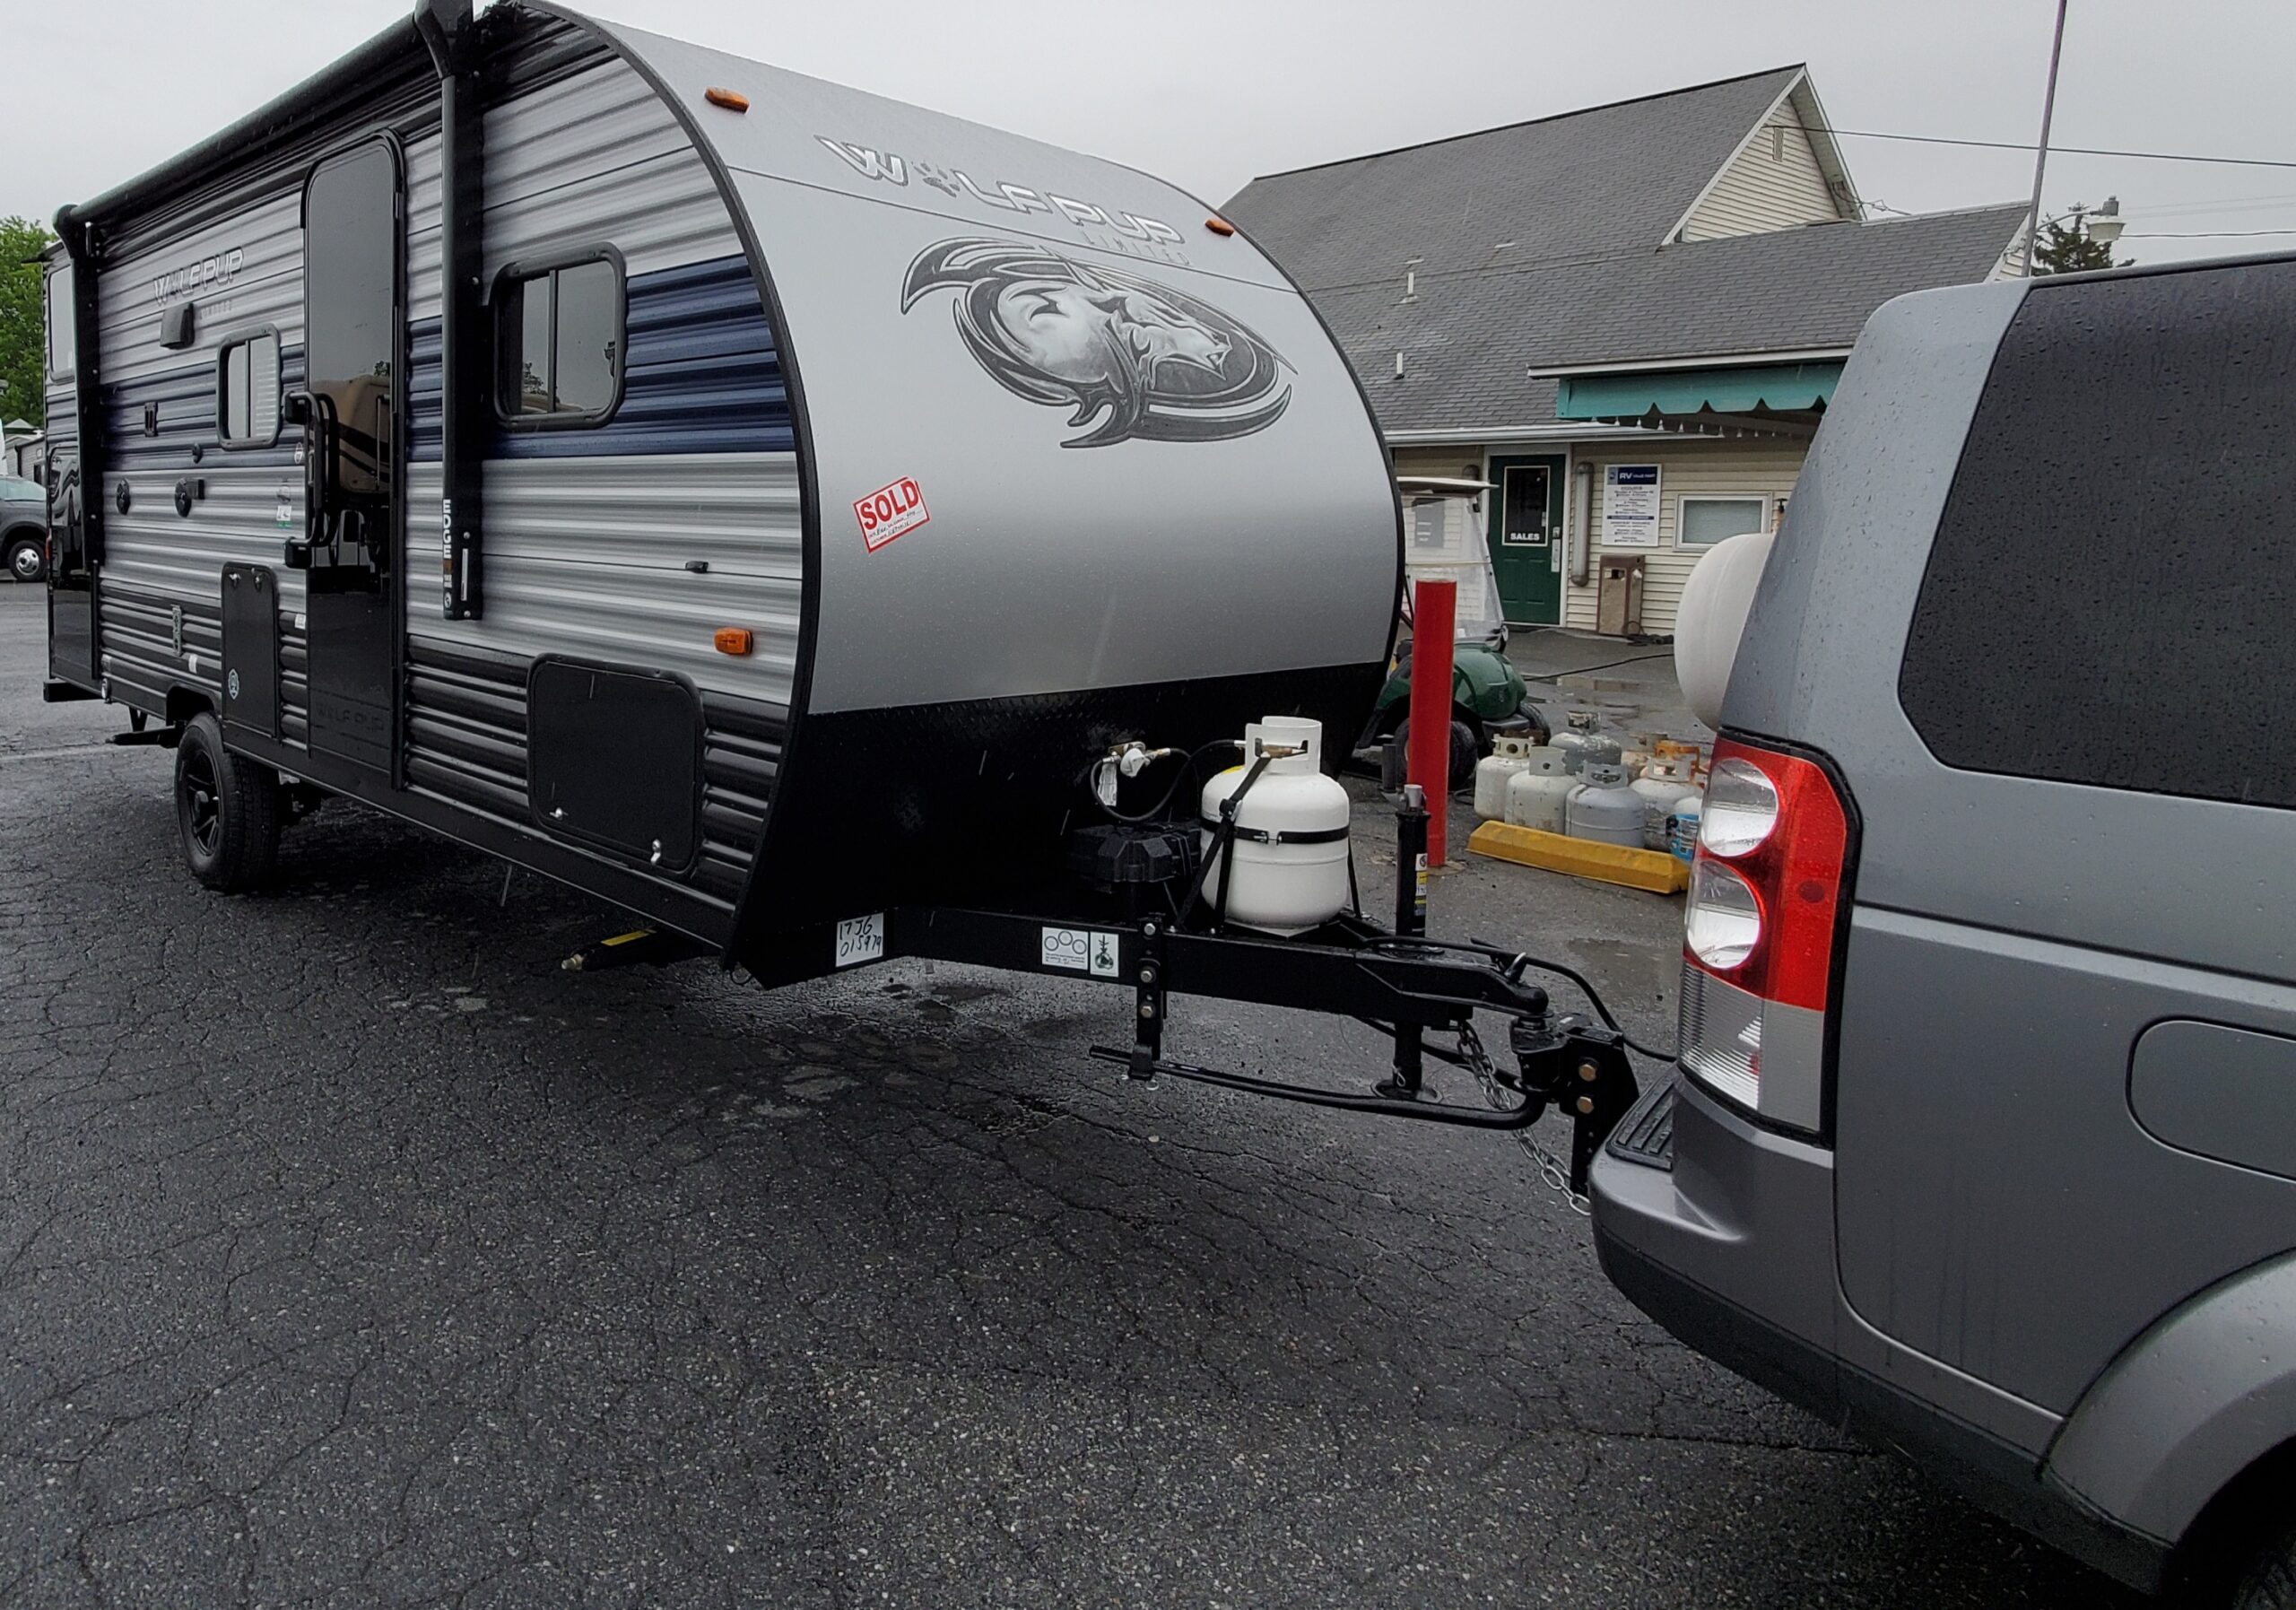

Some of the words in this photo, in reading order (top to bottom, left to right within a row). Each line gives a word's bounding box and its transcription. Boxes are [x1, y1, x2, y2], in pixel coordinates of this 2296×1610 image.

[813, 135, 1053, 214] WLF
[1082, 231, 1190, 266] LIMITED
[1619, 472, 1632, 480] RV
[859, 480, 919, 530] SOLD
[442, 499, 452, 559] EDGE
[1509, 533, 1540, 541] SALES
